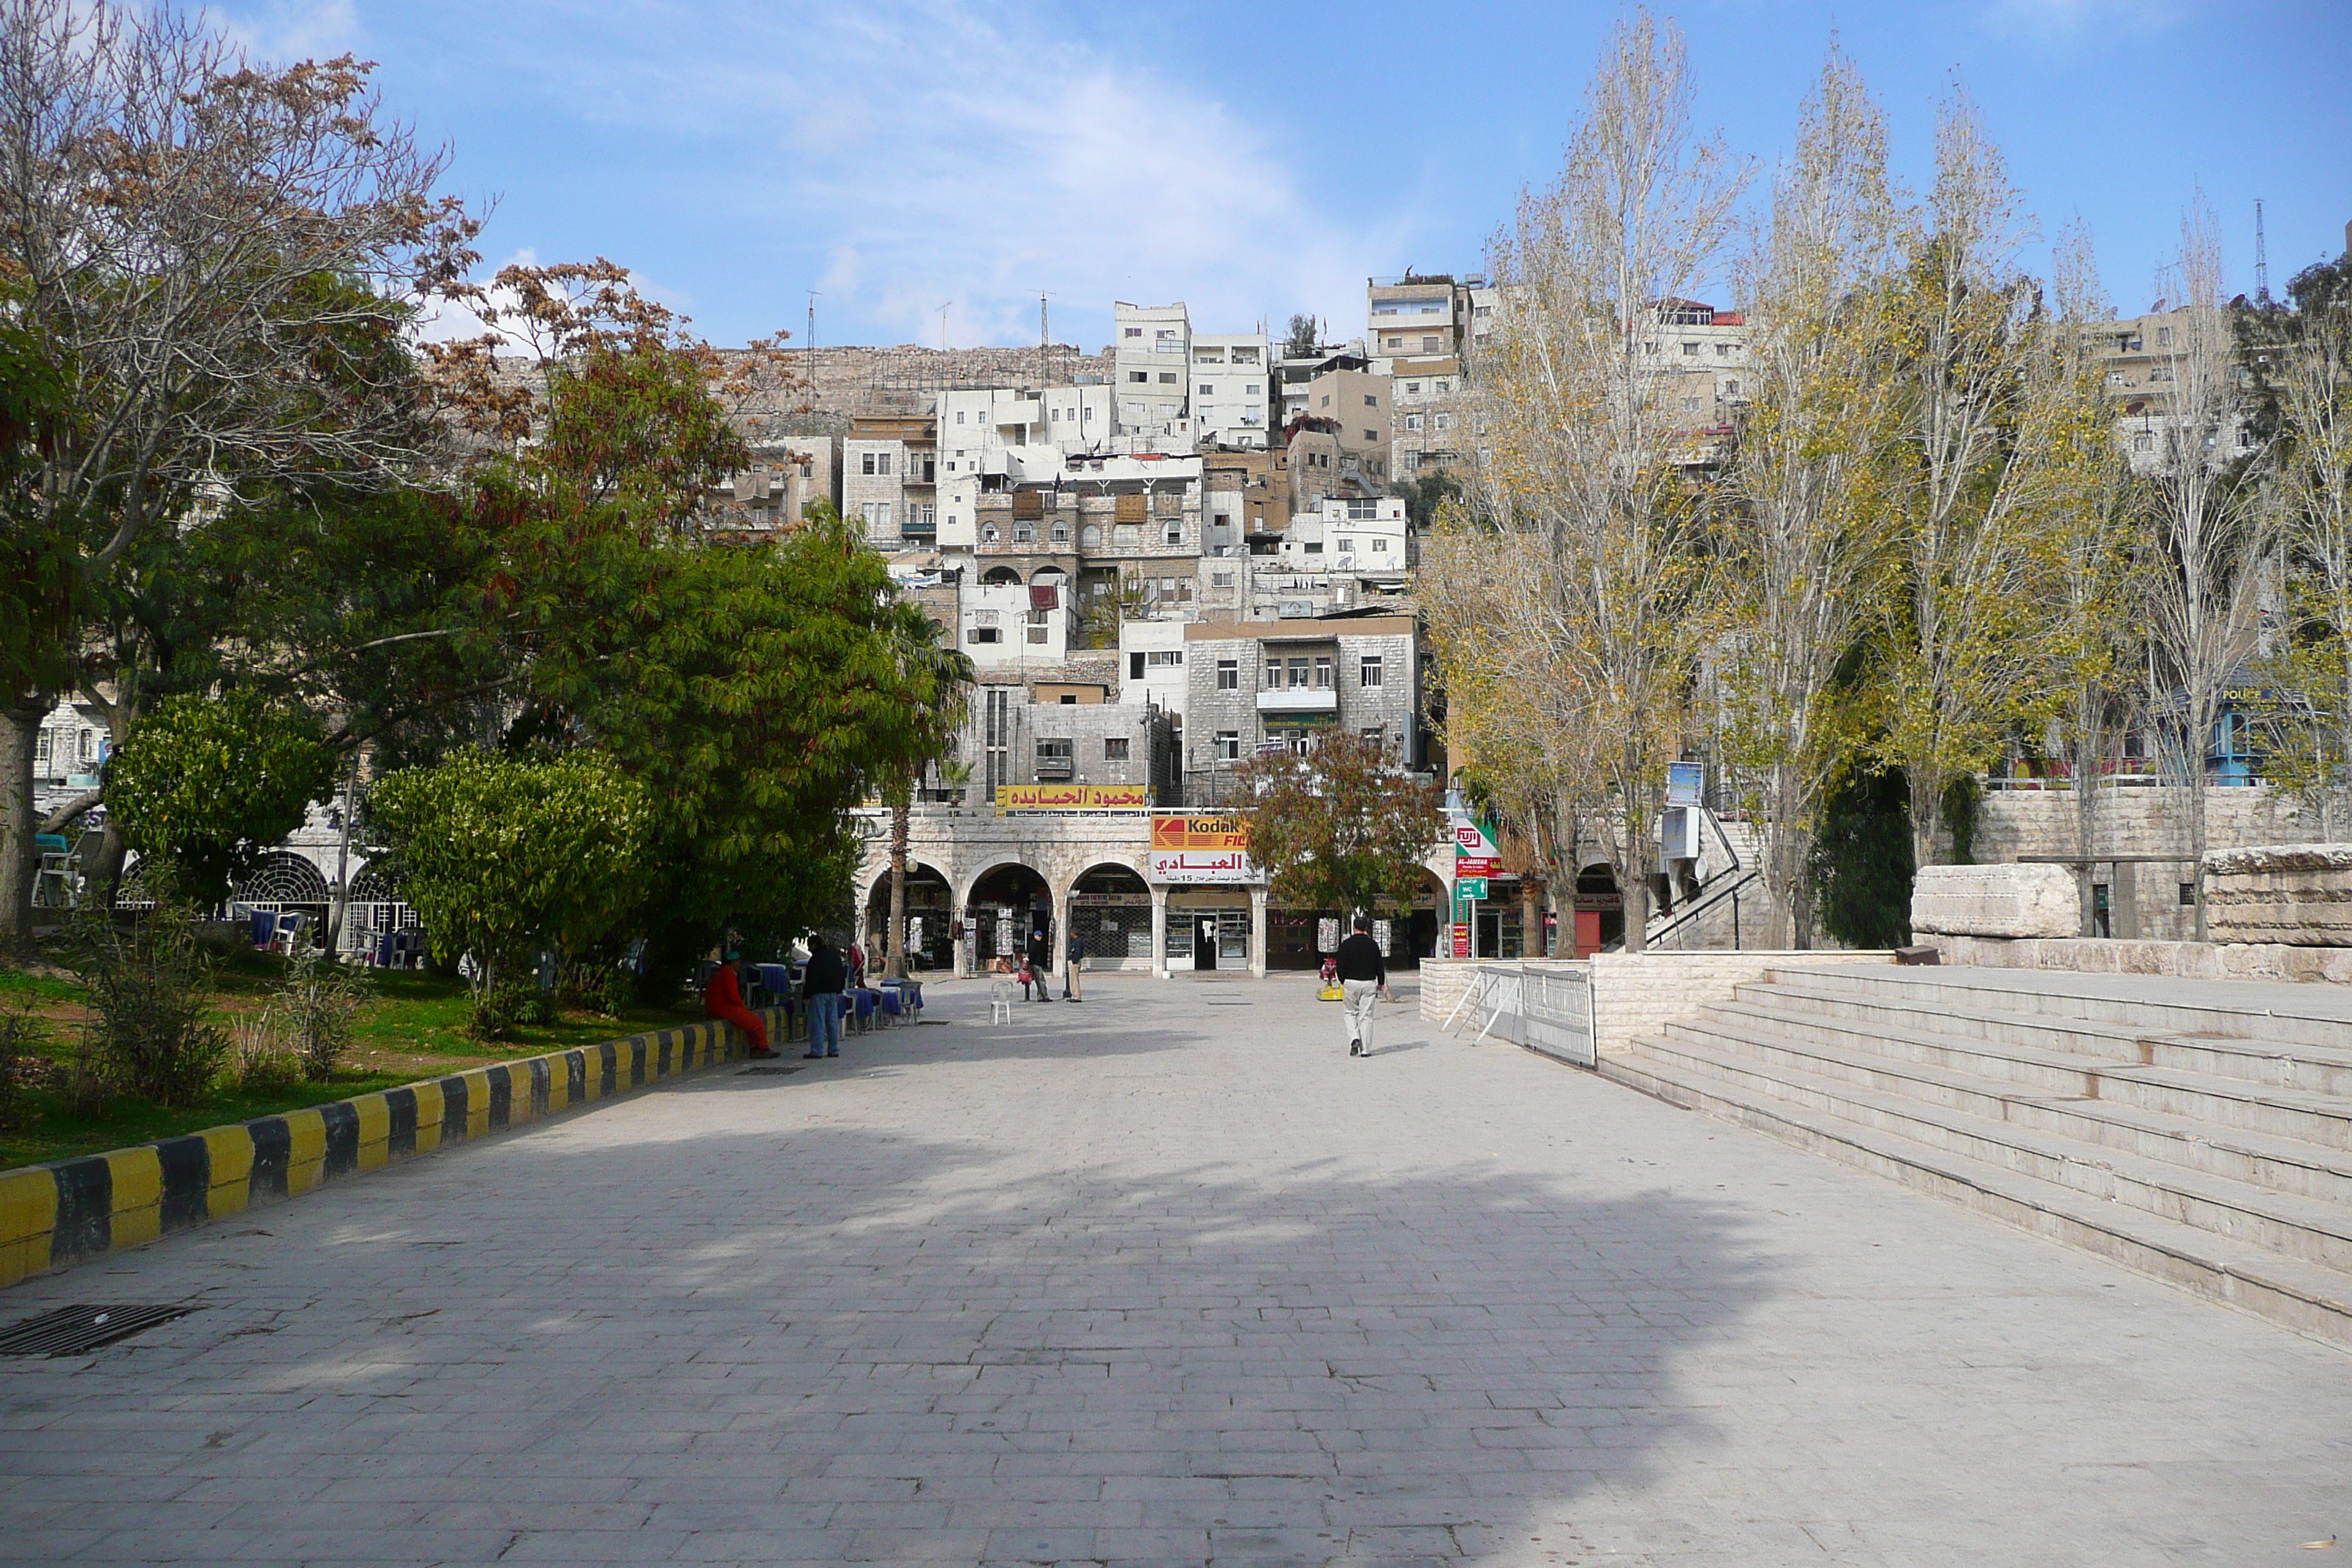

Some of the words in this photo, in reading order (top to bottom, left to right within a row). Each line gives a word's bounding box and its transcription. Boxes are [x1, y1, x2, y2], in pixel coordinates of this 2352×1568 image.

[1093, 791, 1145, 808] محمود
[1188, 819, 1240, 833] Kodak
[1224, 835, 1248, 846] FIL
[1154, 853, 1243, 875] العبادي
